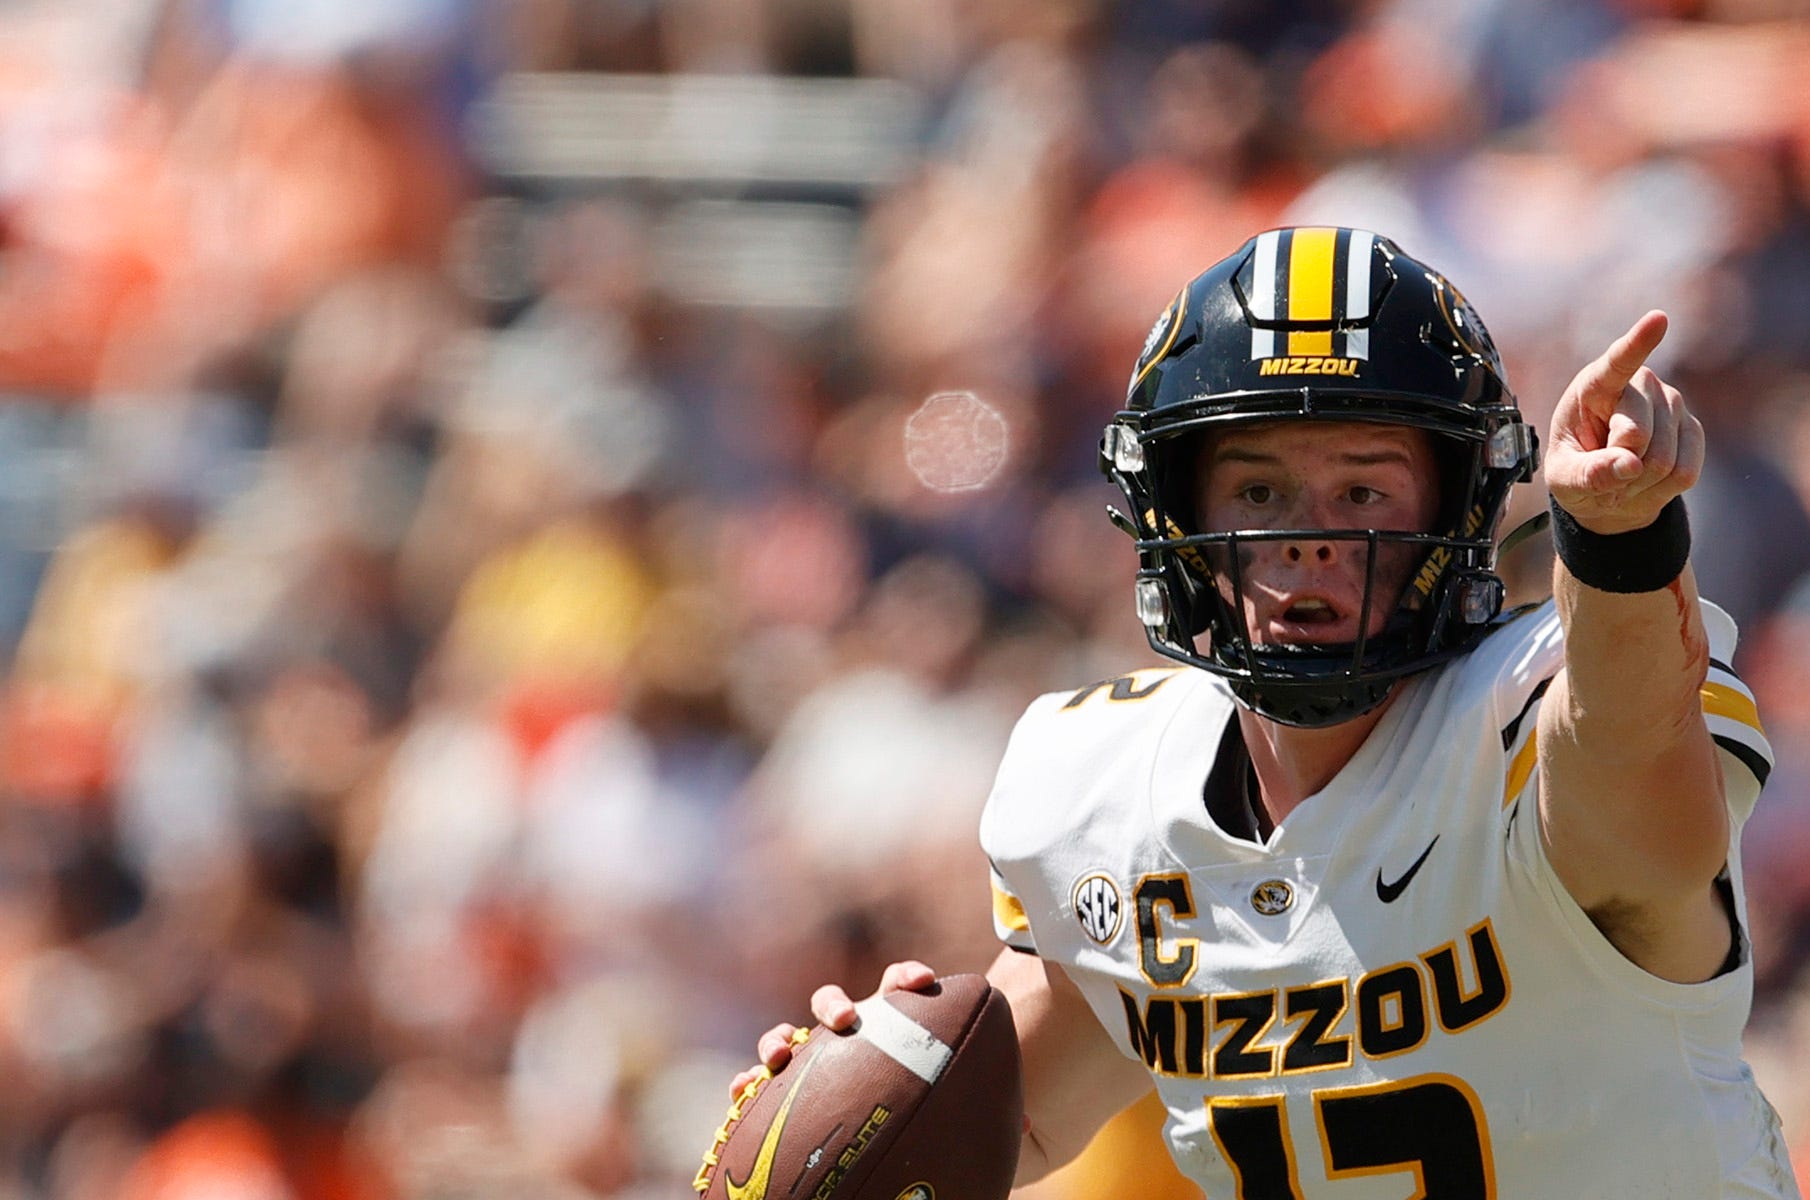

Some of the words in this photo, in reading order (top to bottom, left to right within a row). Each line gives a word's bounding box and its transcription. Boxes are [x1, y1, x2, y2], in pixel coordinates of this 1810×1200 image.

[1259, 356, 1357, 376] MIZZOU
[1075, 876, 1120, 943] SEC
[1133, 872, 1199, 989] C
[1118, 918, 1511, 1080] MIZZOU
